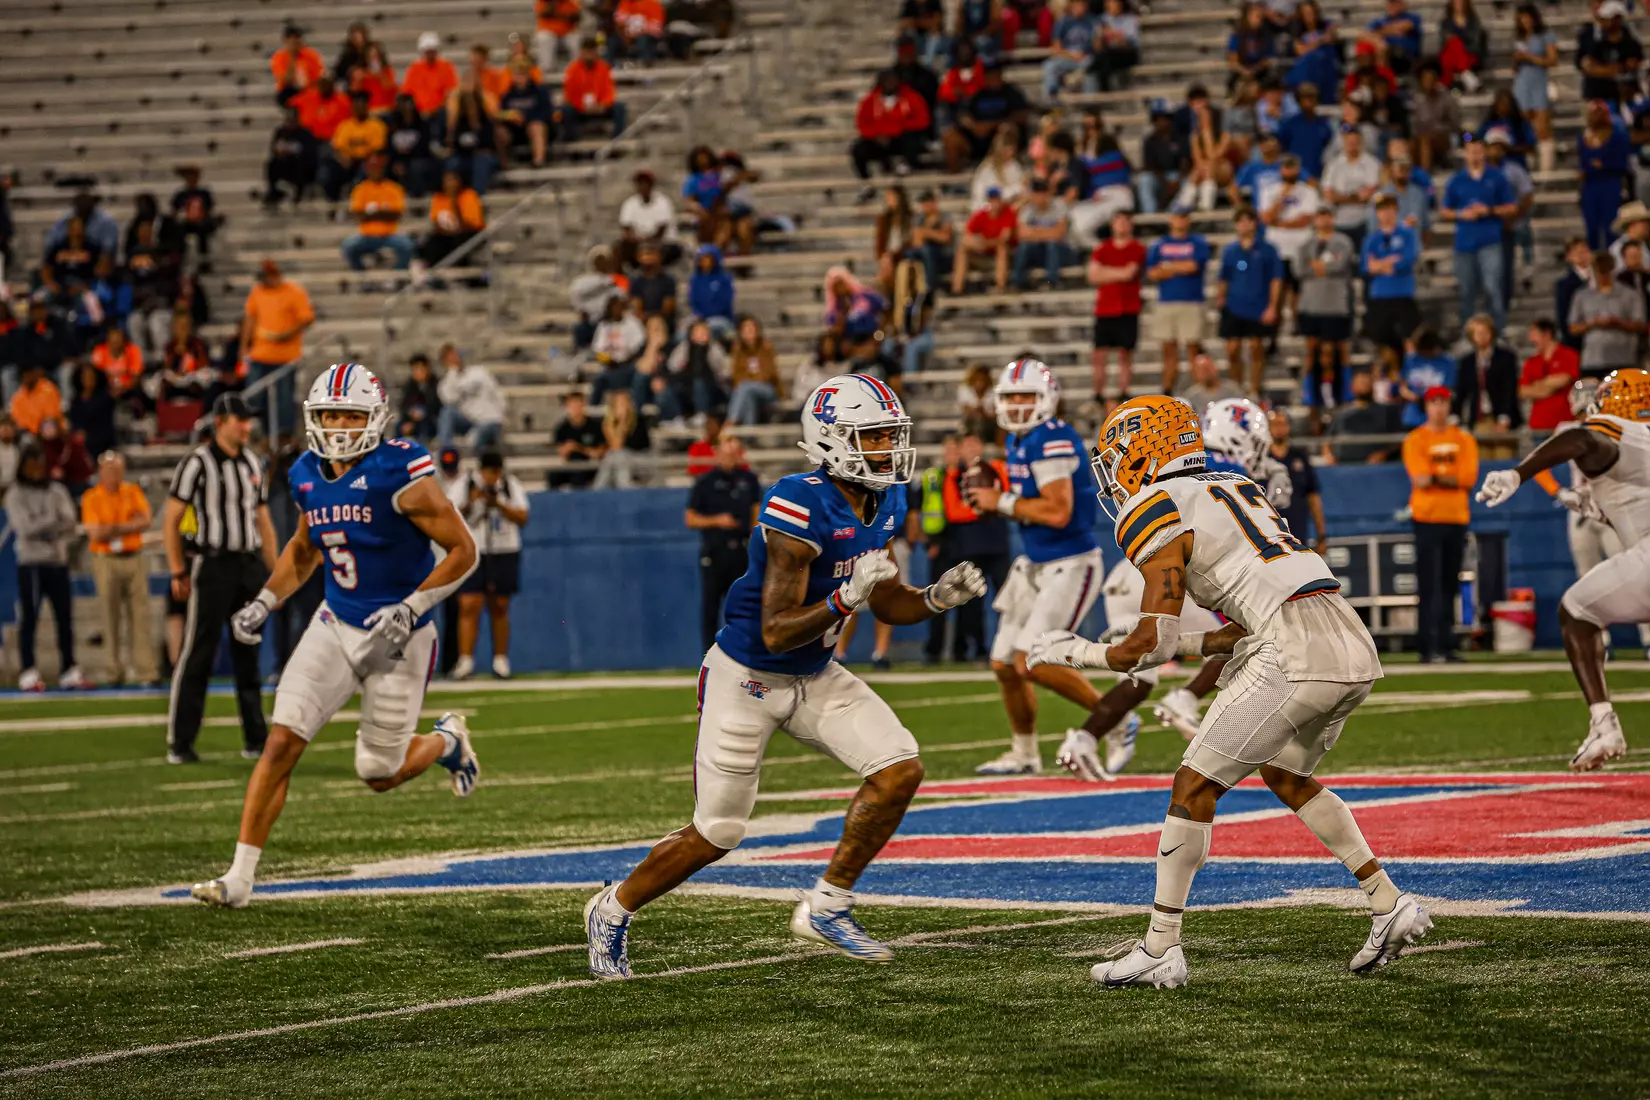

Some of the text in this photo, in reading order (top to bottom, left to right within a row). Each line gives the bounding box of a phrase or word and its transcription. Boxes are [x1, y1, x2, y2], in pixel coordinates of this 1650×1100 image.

[1106, 415, 1141, 446] 915
[1180, 433, 1195, 443] LUKE
[1207, 481, 1313, 563] 13
[321, 530, 358, 591] 5
